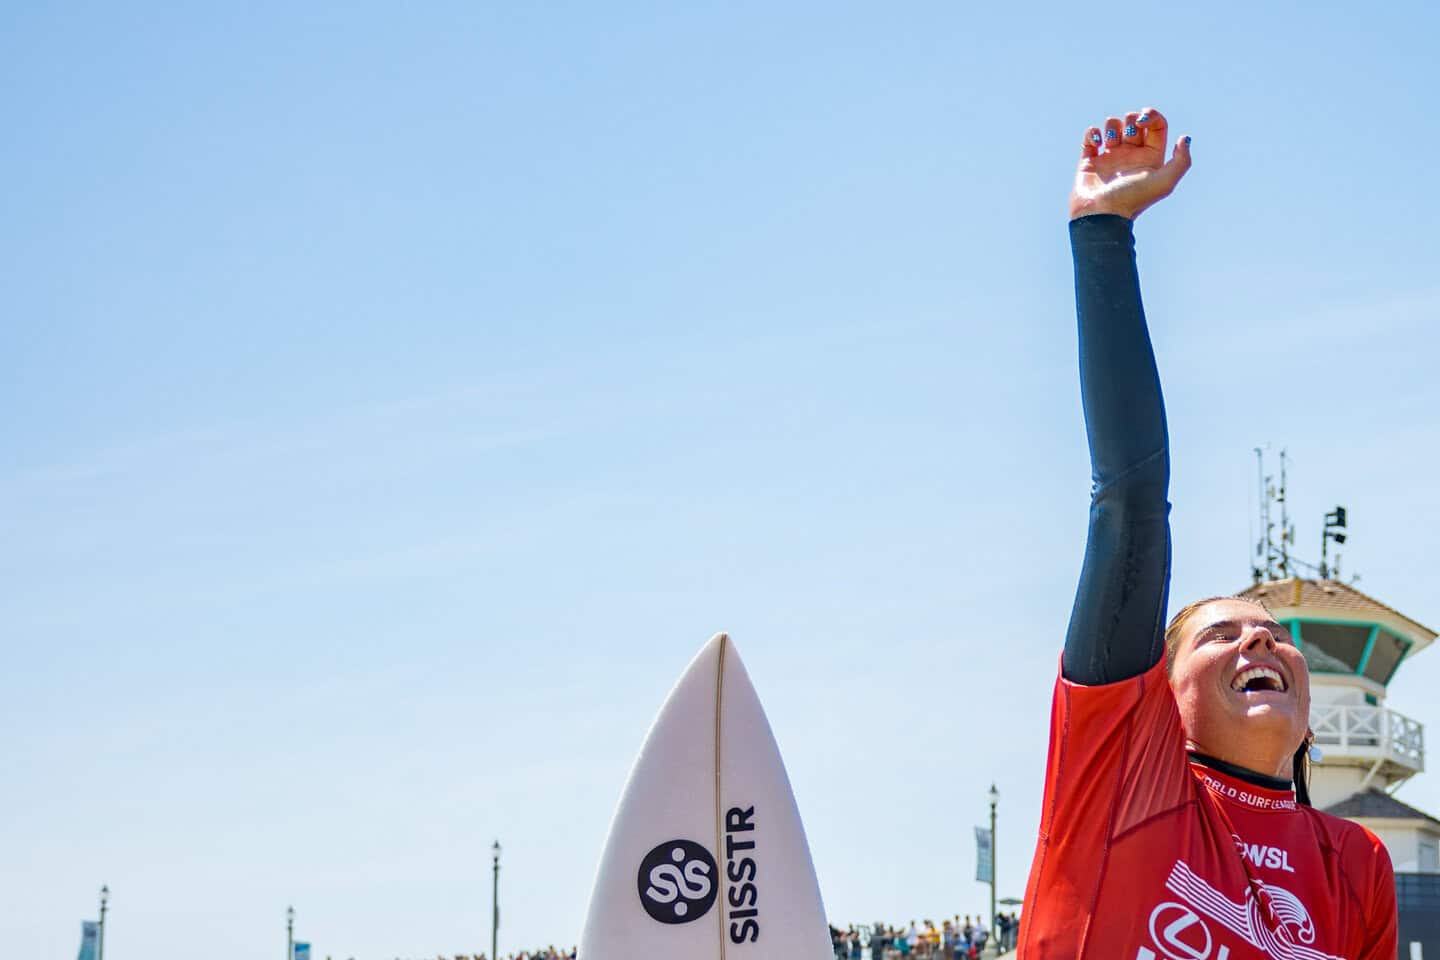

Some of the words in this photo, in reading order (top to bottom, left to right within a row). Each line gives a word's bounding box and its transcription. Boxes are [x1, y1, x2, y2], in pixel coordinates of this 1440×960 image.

[1202, 775, 1238, 798] ORLD
[1238, 791, 1272, 809] SURF
[1243, 842, 1295, 873] WSL
[725, 805, 760, 945] SISSTR
